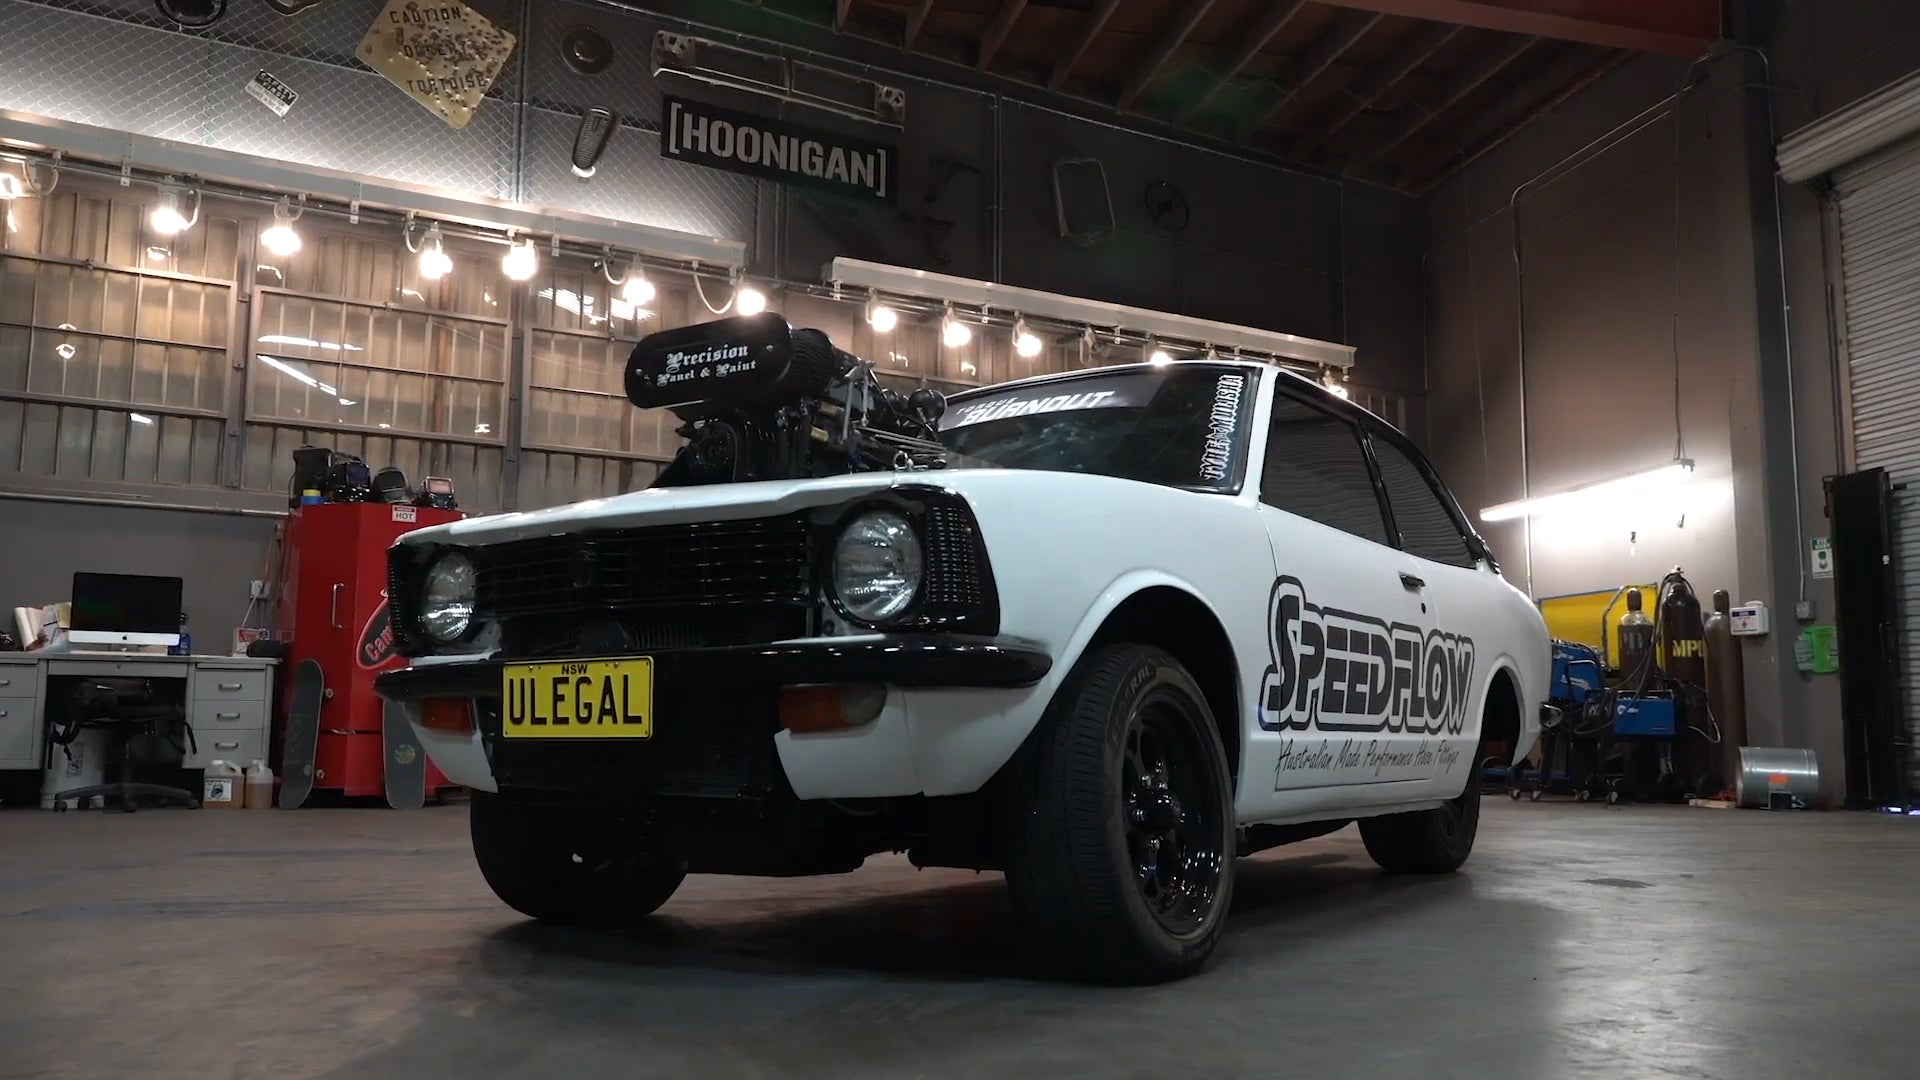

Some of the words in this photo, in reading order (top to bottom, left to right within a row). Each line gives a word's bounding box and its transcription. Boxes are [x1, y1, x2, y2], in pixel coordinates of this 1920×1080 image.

[389, 6, 463, 24] CAUTION
[258, 72, 296, 99] SAFETY
[406, 74, 488, 93] TORTOISE
[665, 343, 749, 374] Precision
[656, 369, 695, 388] Panel
[699, 366, 712, 378] &
[715, 359, 757, 378] Paint
[955, 390, 1116, 428] BURNOUT
[956, 396, 1018, 415] TORQUE
[395, 512, 413, 520] HOT
[561, 664, 588, 675] NSW
[1261, 582, 1473, 732] SPEEDFLOW
[509, 674, 642, 725] ULEGAL
[1275, 738, 1333, 771] Australian
[1333, 738, 1362, 771] Made
